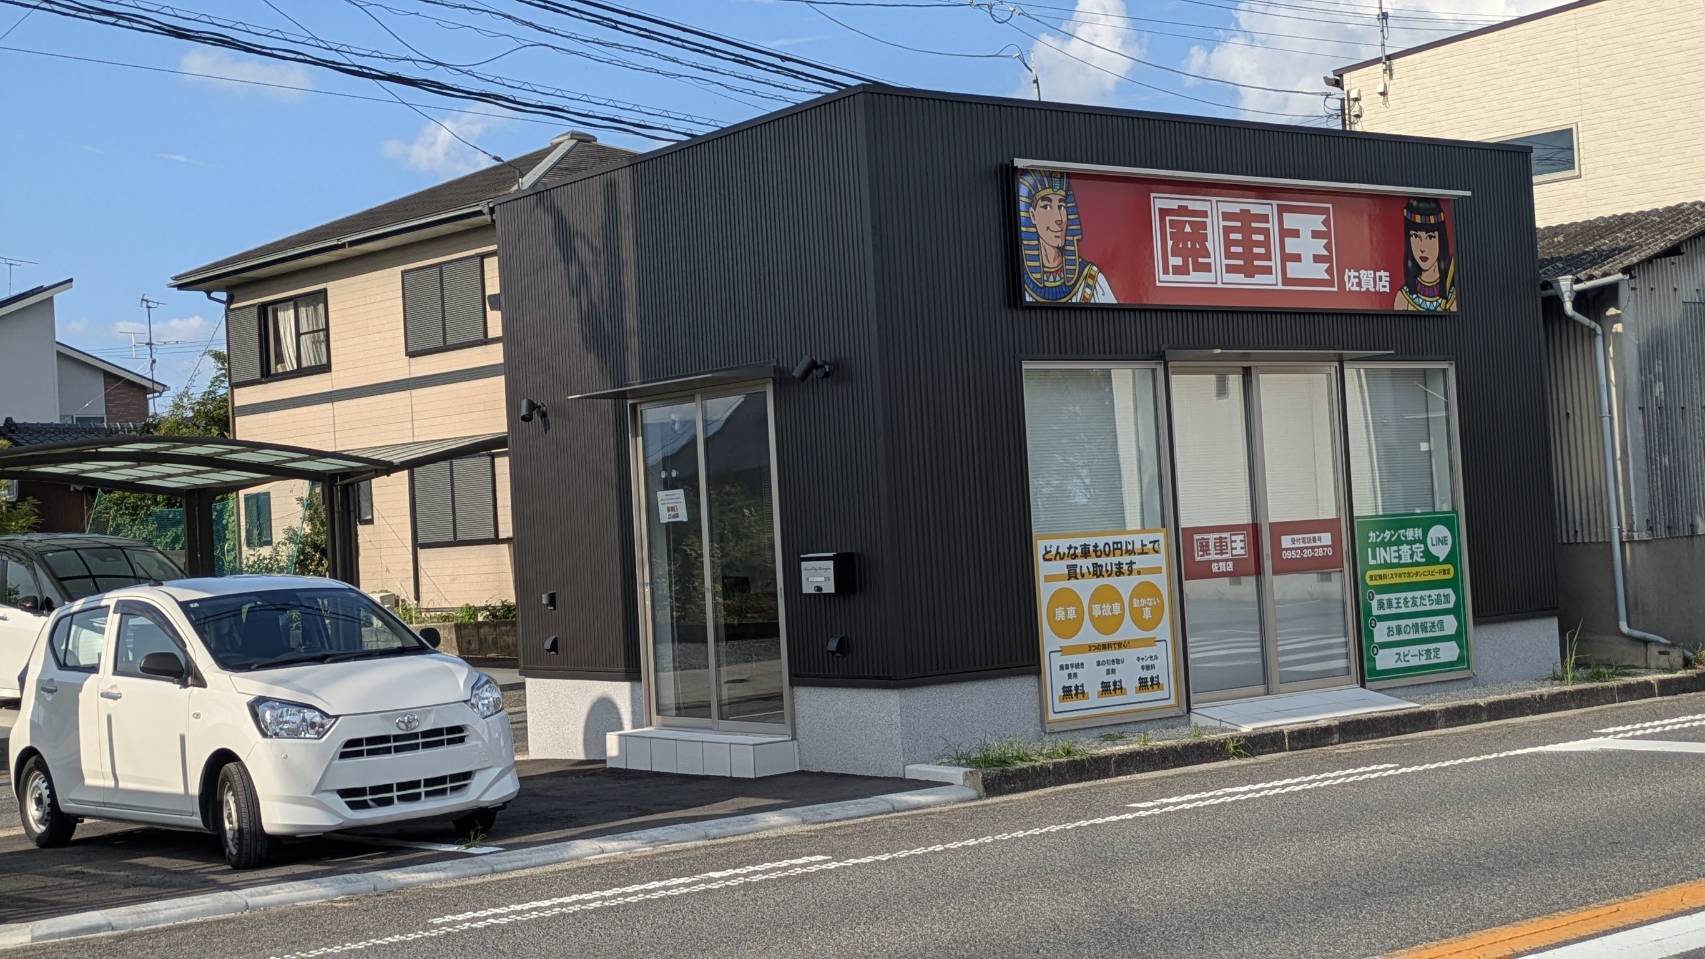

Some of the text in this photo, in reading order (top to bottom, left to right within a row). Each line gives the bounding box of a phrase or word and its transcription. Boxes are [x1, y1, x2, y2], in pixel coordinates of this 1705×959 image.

[1153, 195, 1335, 289] 廃車王
[1343, 268, 1390, 293] 佐賀店
[1368, 528, 1423, 542] カンタンで便利
[1430, 535, 1449, 547] LINE
[1042, 539, 1160, 561] どんな車も0円以上で
[1194, 531, 1248, 560] 廃車王
[1282, 547, 1333, 559] 0952-20-2870
[1368, 543, 1426, 565] LINE査定
[1066, 560, 1141, 581] 買い取ります。
[1092, 602, 1121, 618] 事故車
[1376, 593, 1451, 611] 廃車王を友だち追加
[1055, 606, 1077, 621] 廃車
[1142, 607, 1152, 620] 車
[1386, 619, 1445, 637] お車の情報送信
[1394, 647, 1441, 664] スピード査定
[1100, 679, 1123, 696] 無料
[1138, 675, 1160, 691] 無料
[1061, 683, 1086, 701] 無料
